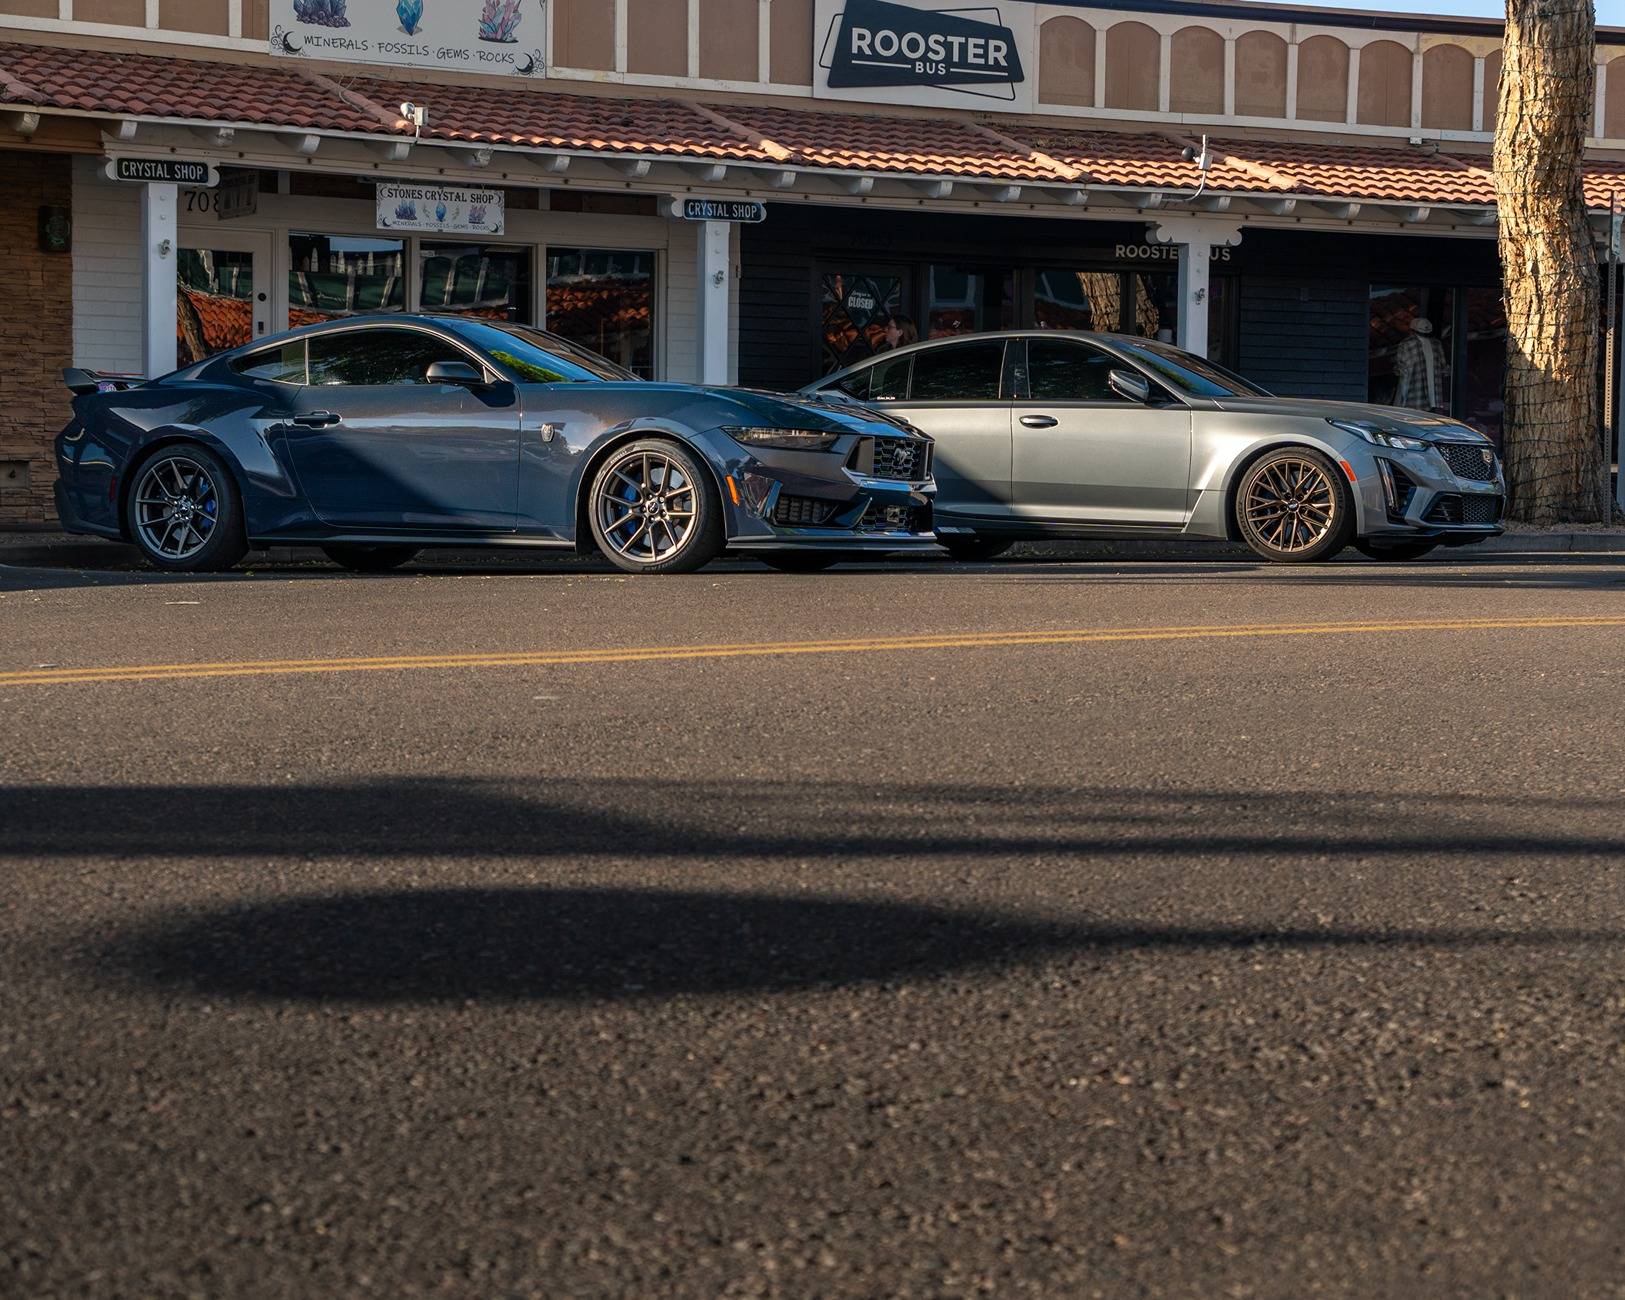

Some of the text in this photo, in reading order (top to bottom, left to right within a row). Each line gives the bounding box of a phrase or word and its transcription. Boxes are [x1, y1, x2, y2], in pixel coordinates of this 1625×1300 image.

[303, 35, 515, 64] MINERALS FOSSILS GEMS ROCKS
[851, 27, 1008, 67] ROOSTER
[915, 61, 946, 75] BUS
[122, 161, 204, 180] CRYSTAL SHOP
[387, 188, 494, 204] STONES CRYSTAL SHOP
[688, 202, 757, 218] CRYSTAL SHOP
[1115, 244, 1231, 261] ROOSTE US
[848, 296, 873, 309] CLOSED
